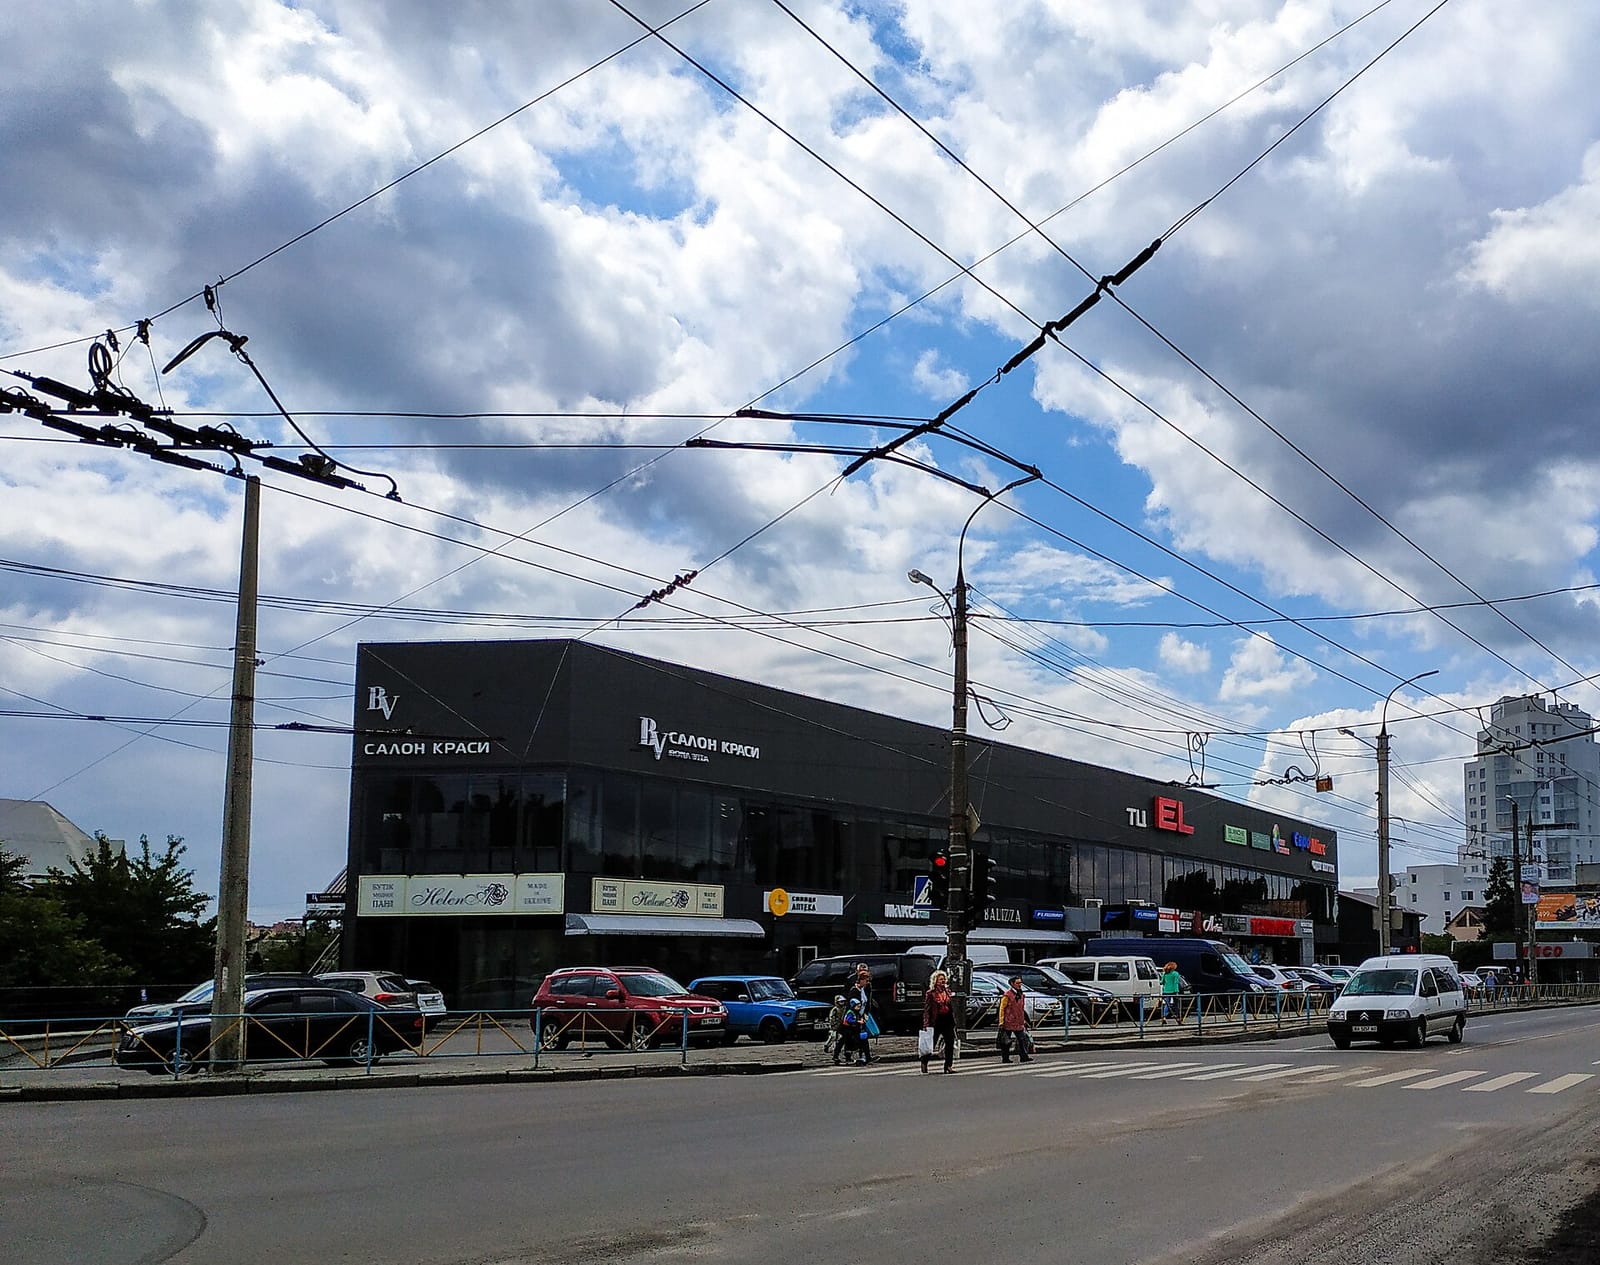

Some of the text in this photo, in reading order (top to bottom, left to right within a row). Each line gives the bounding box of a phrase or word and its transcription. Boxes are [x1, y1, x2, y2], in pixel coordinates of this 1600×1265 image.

[364, 742, 490, 755] САЛОН КРАСИ
[668, 732, 760, 759] САЛОН КРАСИ
[1154, 796, 1195, 835] EL
